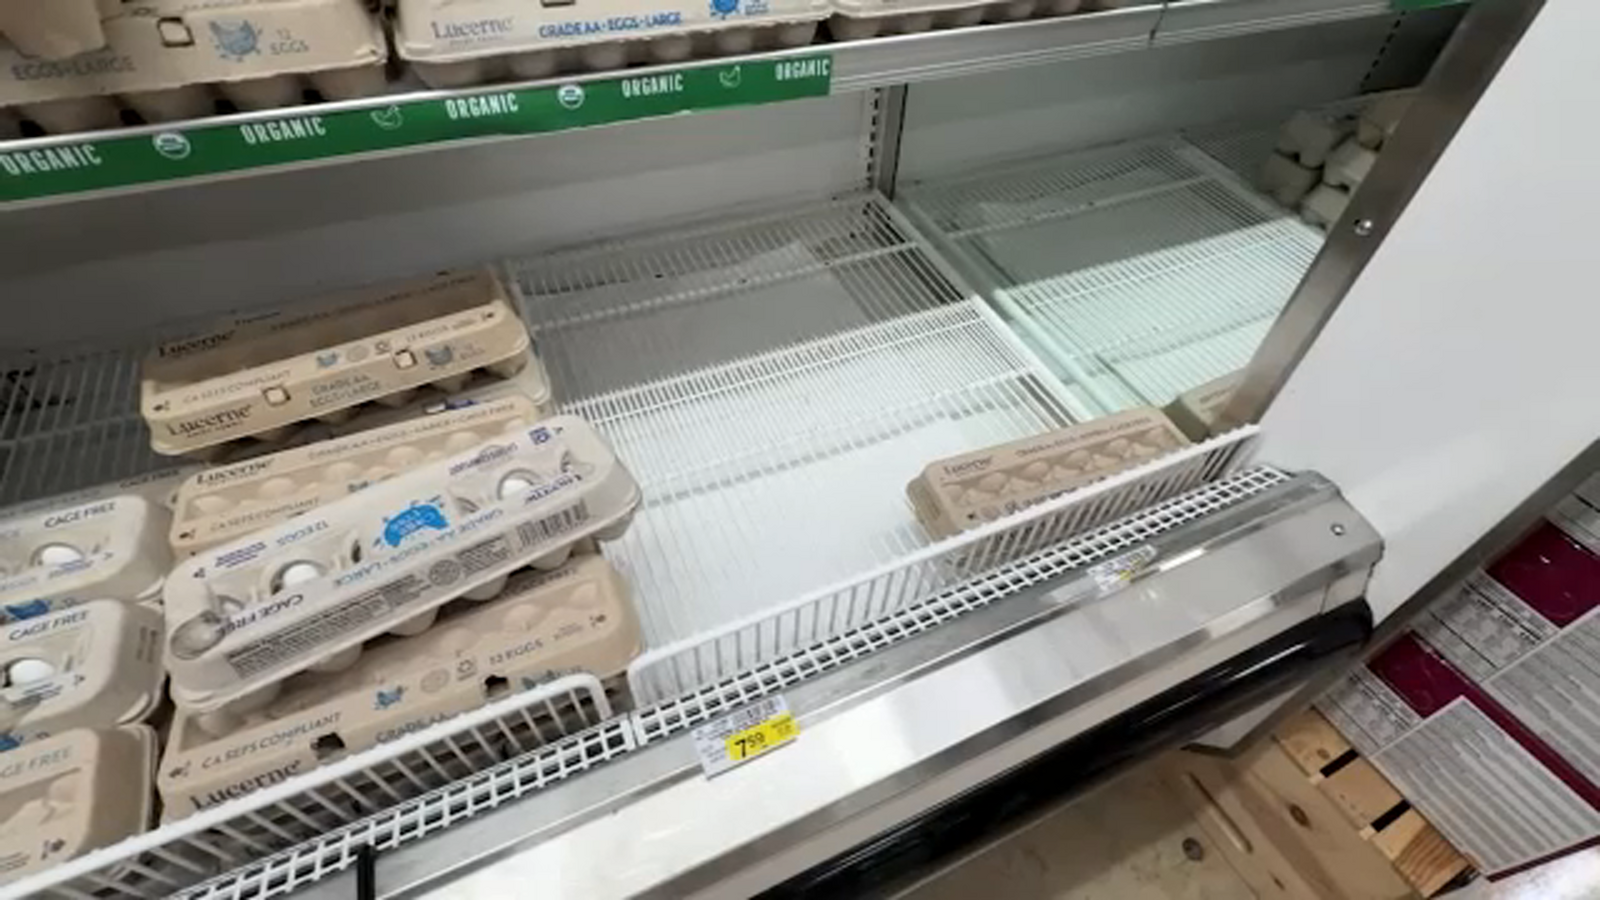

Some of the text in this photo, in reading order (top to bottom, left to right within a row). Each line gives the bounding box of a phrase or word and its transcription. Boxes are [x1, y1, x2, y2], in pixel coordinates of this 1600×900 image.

[431, 15, 514, 40] Lucerne
[538, 23, 581, 38] GRADE
[775, 59, 831, 81] ORGANIC
[621, 74, 684, 99] ORGANIC
[446, 92, 519, 120] ORGANIC
[240, 117, 326, 144] ORGANIC
[0, 143, 102, 176] ORGANIC
[166, 404, 252, 436] Lucerne
[44, 501, 116, 528] CAGE FREE
[258, 593, 304, 619] CAGE
[9, 610, 90, 641] CAGE FREE
[506, 638, 544, 660] EGGS
[259, 711, 342, 749] COMPLIANT
[28, 744, 74, 769] FREE
[189, 761, 298, 811] Lucerne
